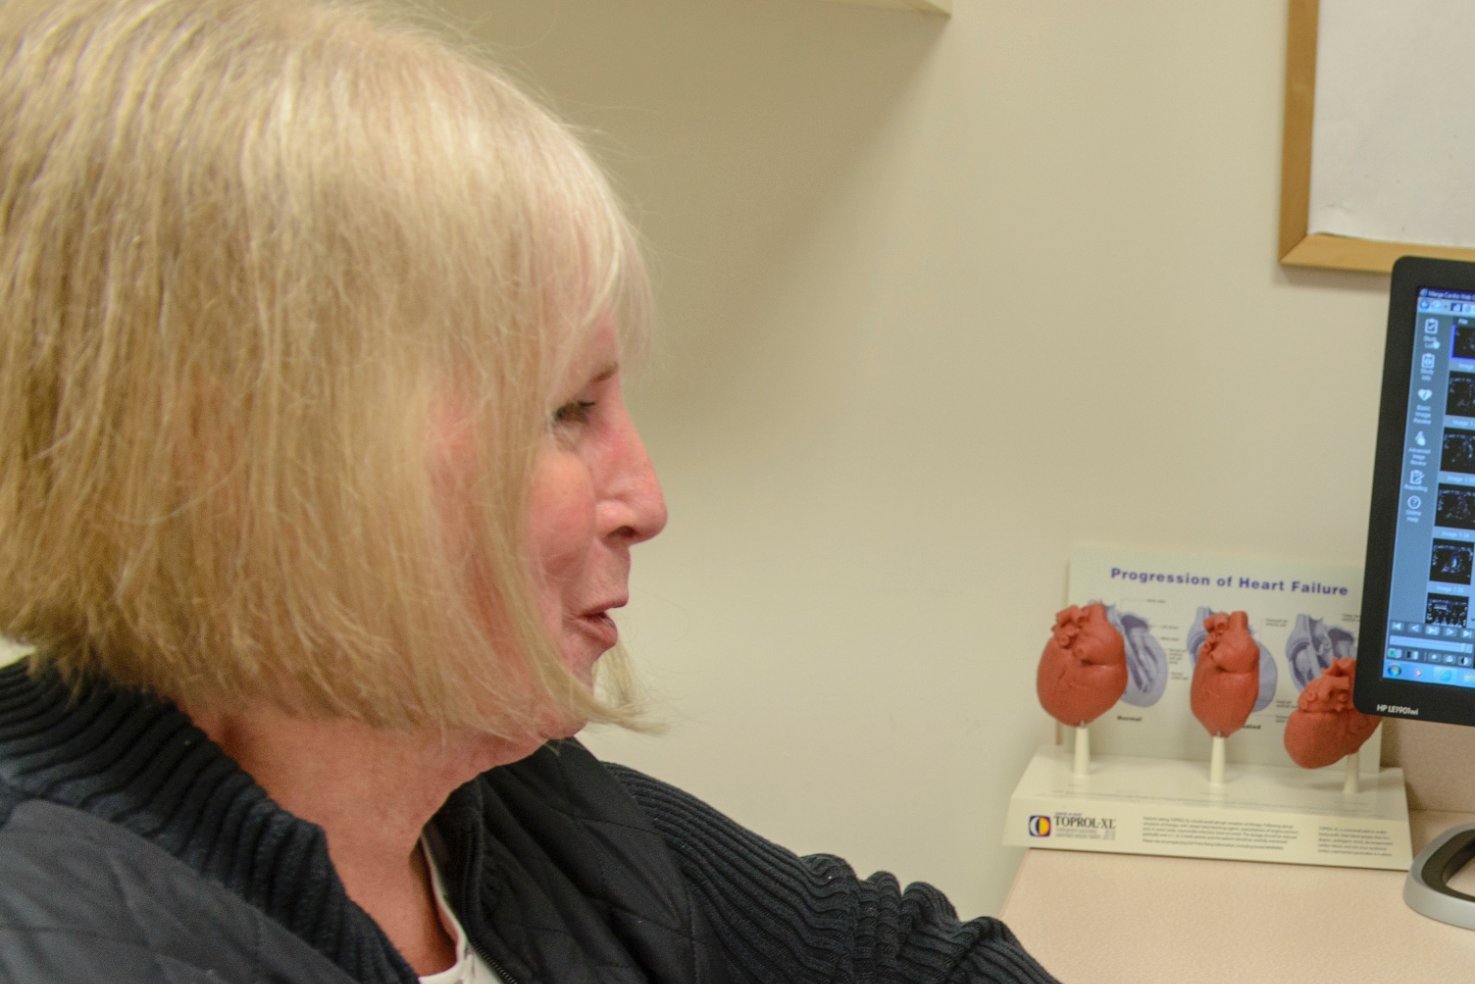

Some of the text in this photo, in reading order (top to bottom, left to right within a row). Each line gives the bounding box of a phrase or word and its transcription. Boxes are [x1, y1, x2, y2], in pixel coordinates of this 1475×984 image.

[1111, 567, 1349, 596] Progression of Heart Failure
[1054, 816, 1116, 829] TOPROL-XL
